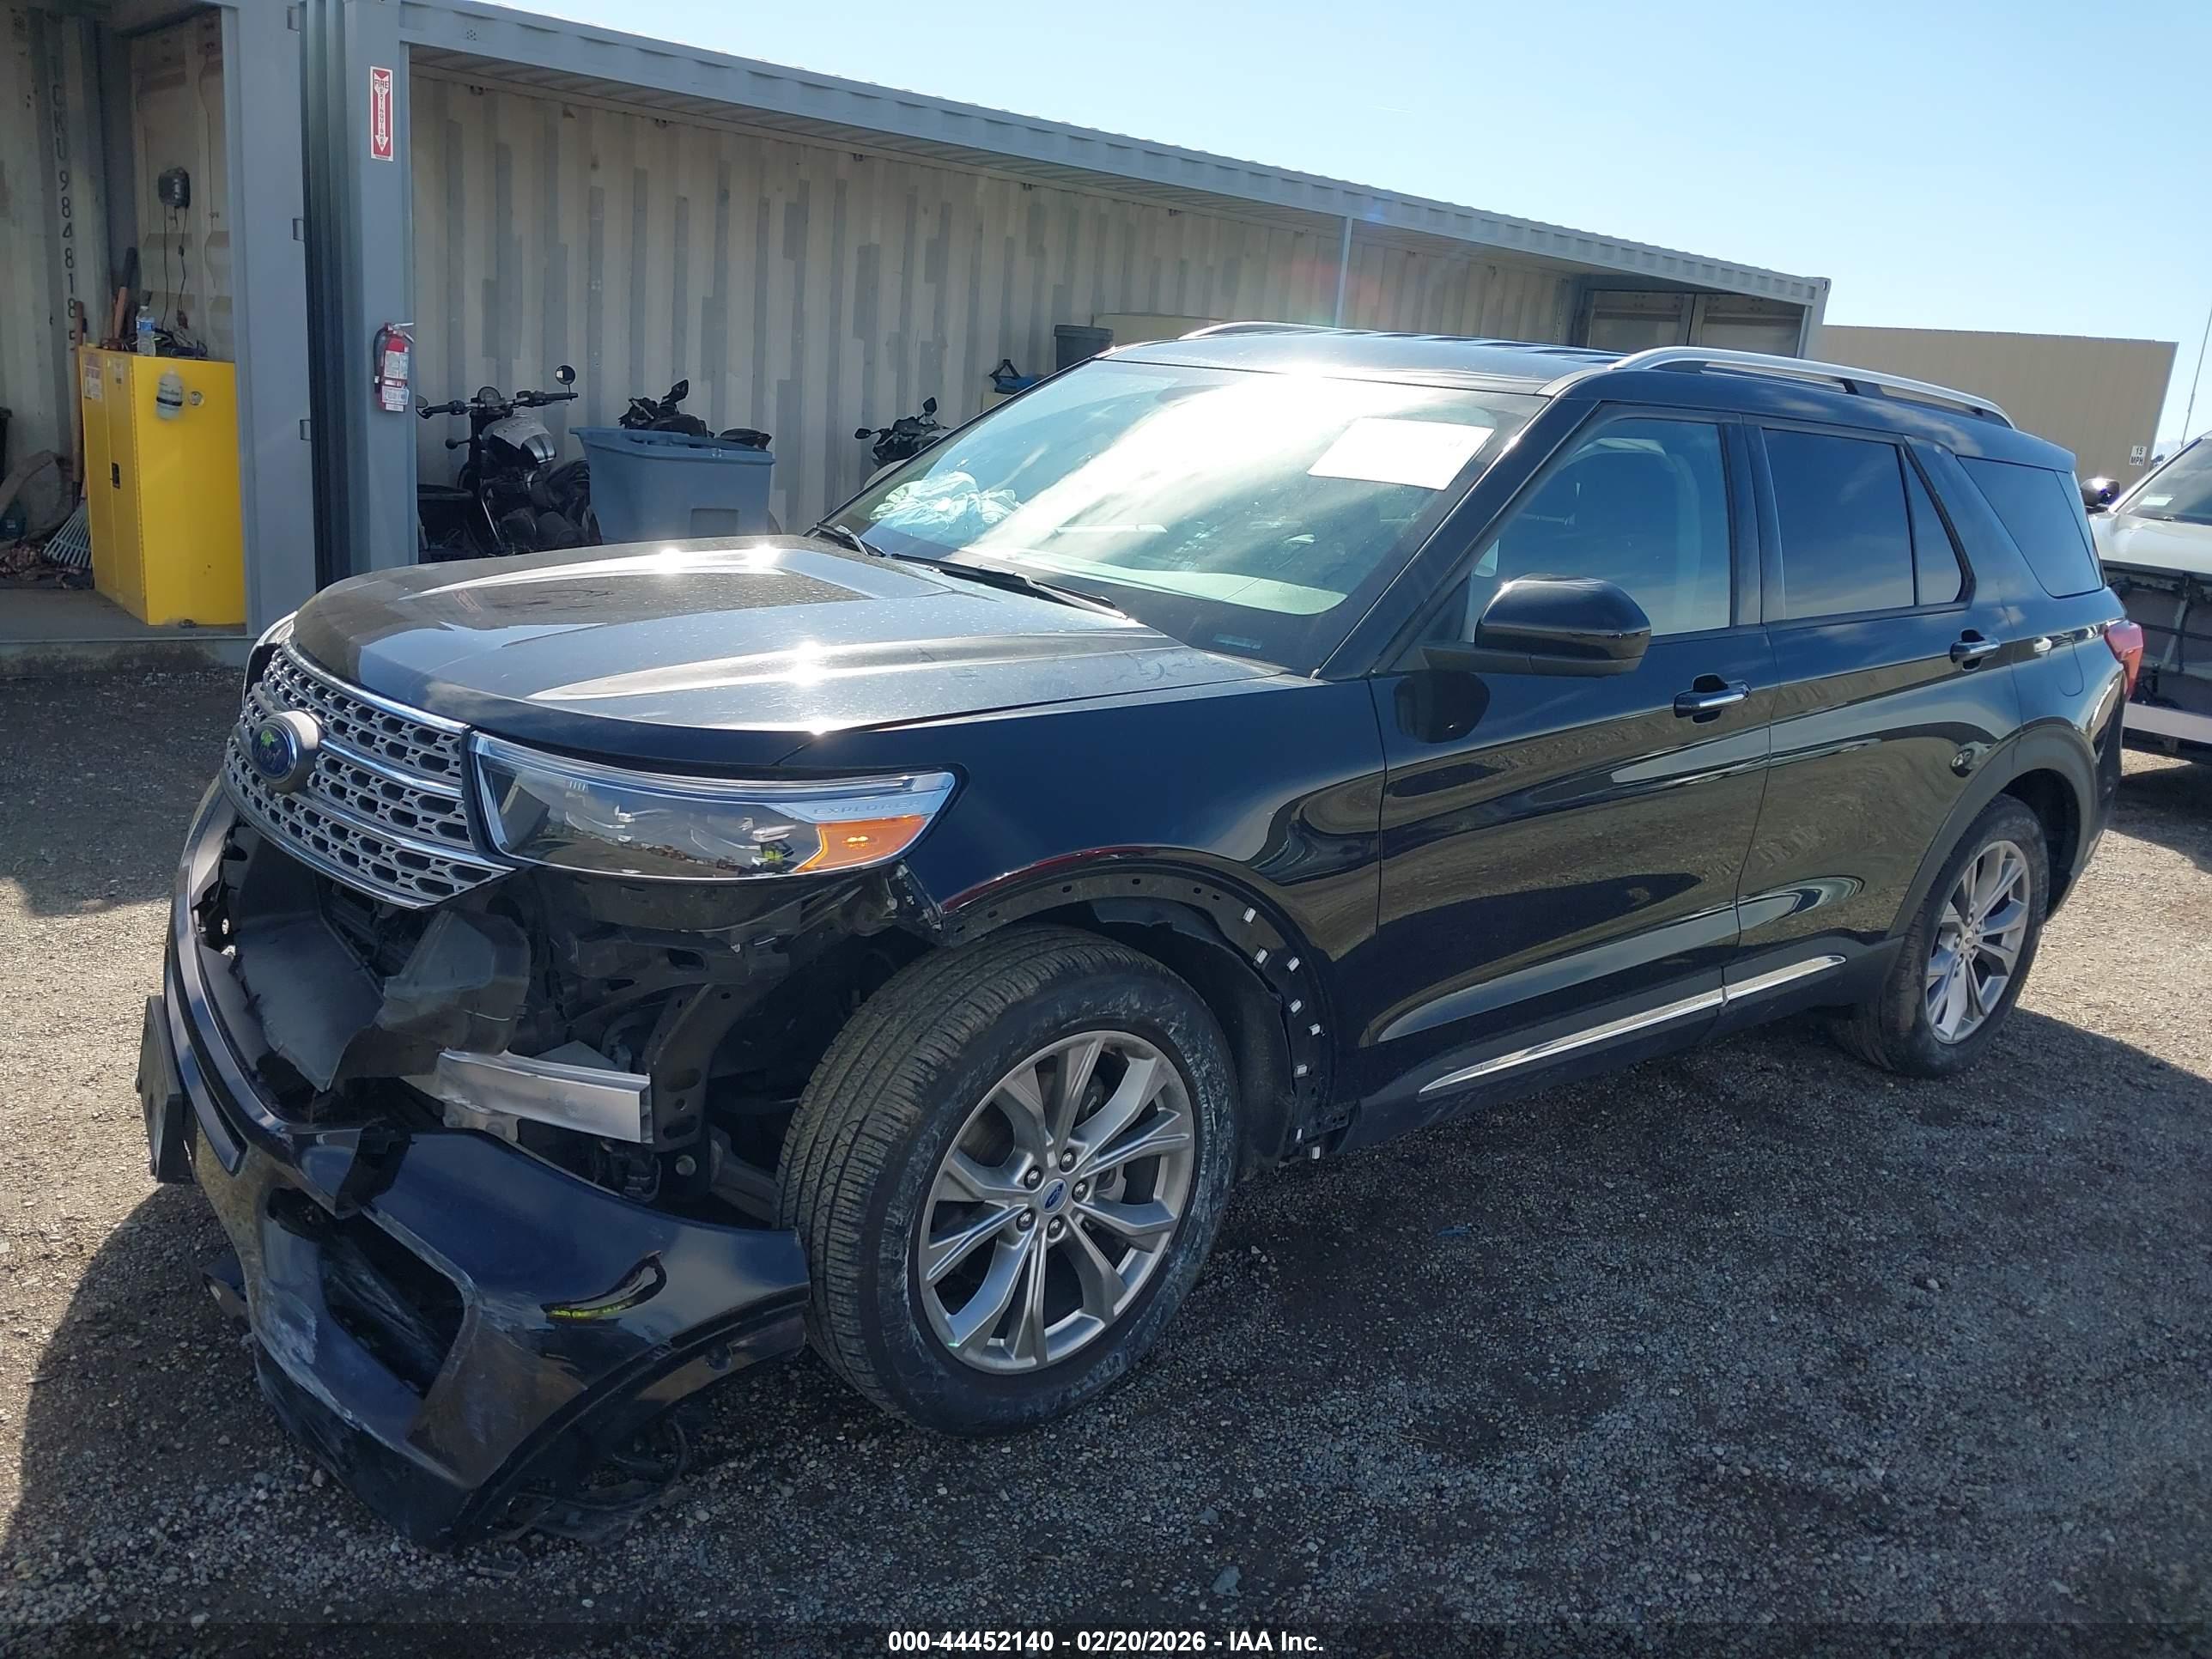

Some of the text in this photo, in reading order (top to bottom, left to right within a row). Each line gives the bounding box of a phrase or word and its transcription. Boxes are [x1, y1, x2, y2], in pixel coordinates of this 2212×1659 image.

[374, 79, 389, 89] FIRE
[2136, 447, 2143, 455] 15
[2130, 456, 2143, 465] MPH
